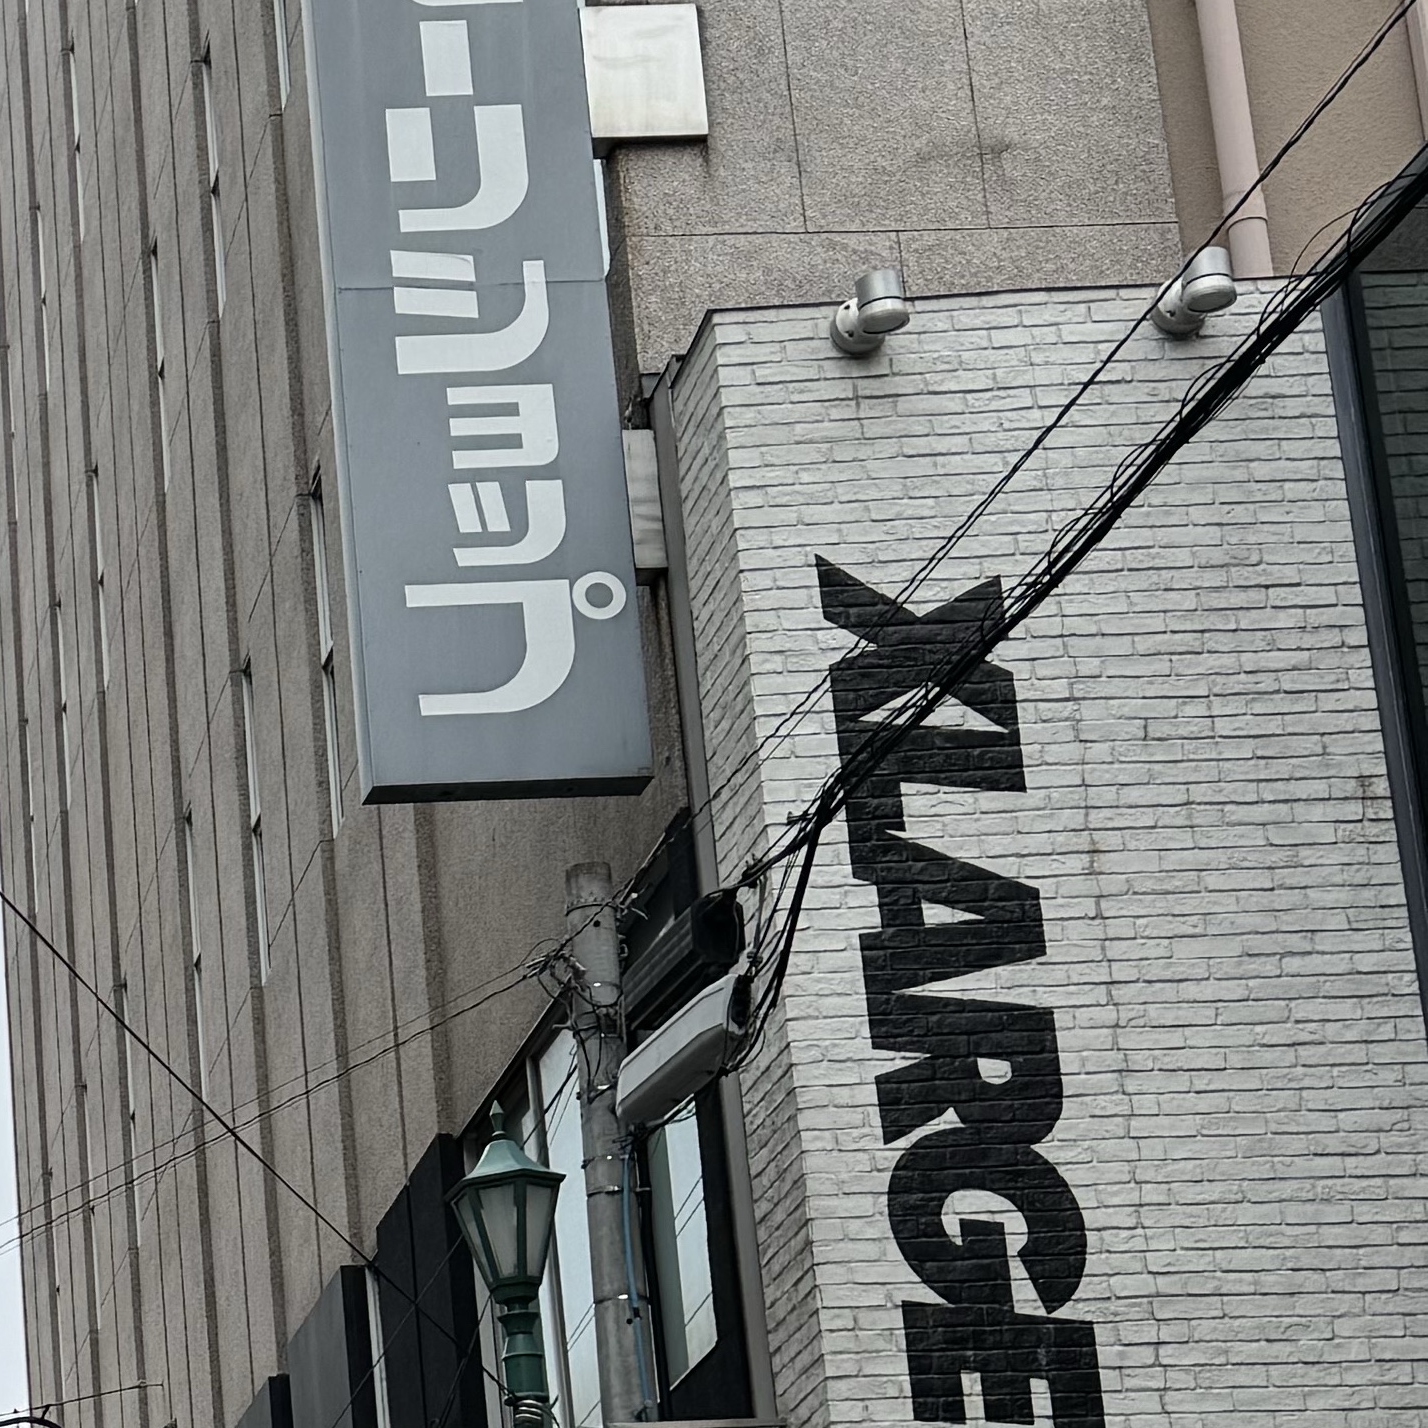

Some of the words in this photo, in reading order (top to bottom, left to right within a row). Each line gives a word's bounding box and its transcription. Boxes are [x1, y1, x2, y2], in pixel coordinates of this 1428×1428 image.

[385, 0, 627, 716] ーリショップ
